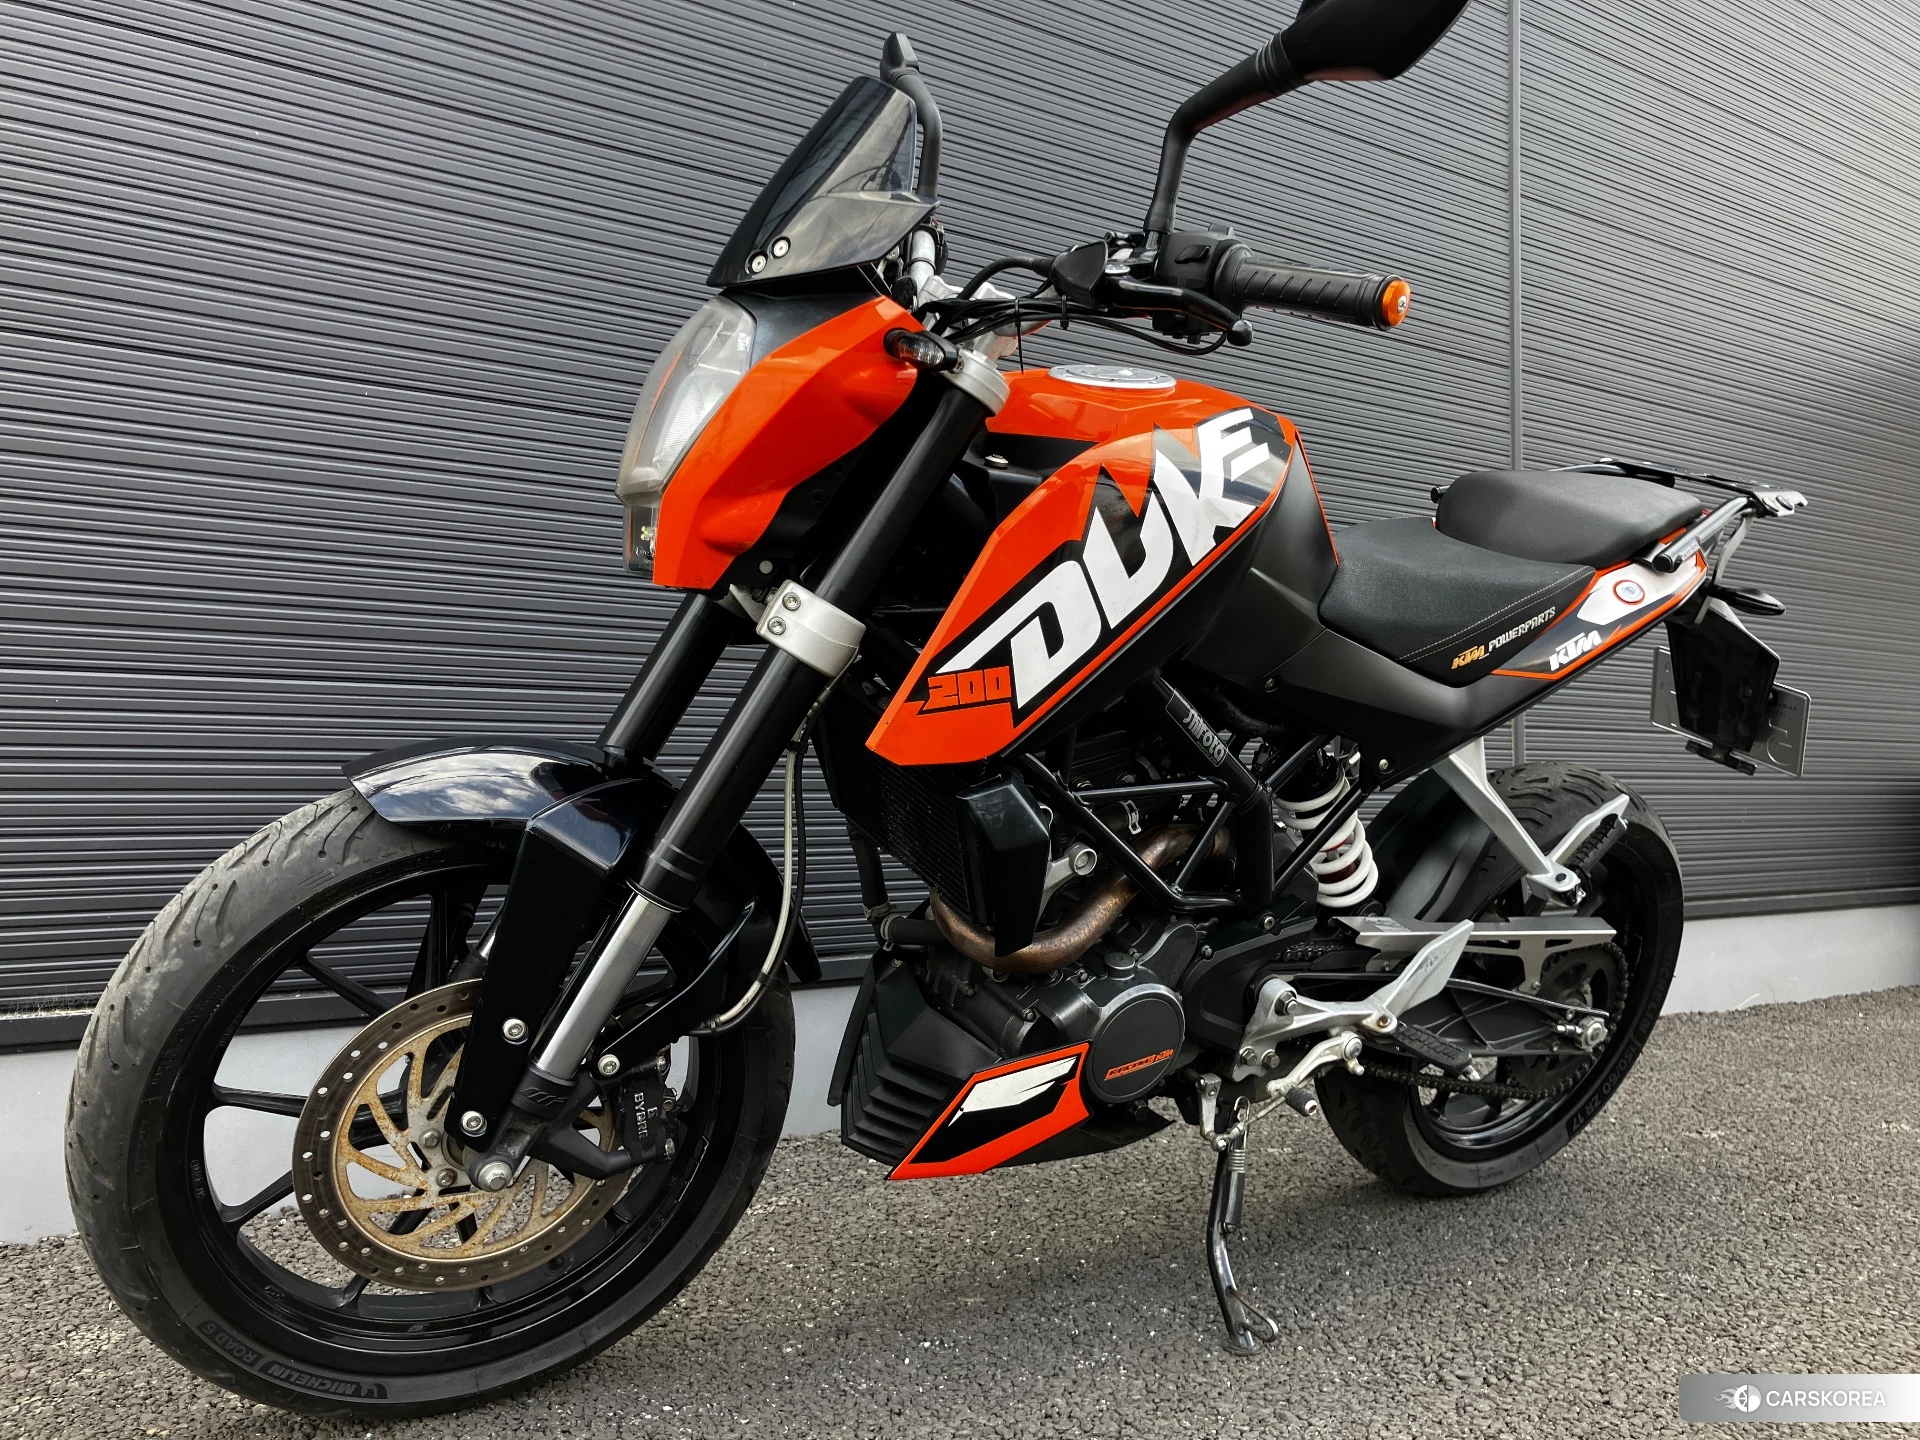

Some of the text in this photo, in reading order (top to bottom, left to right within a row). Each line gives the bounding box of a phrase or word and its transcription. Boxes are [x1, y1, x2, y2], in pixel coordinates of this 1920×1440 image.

[935, 408, 1269, 709] DUKE
[1549, 630, 1603, 671] KTM
[922, 667, 1011, 711] 200
[214, 1333, 256, 1364] ROAD
[267, 1363, 357, 1396] MICHELIN
